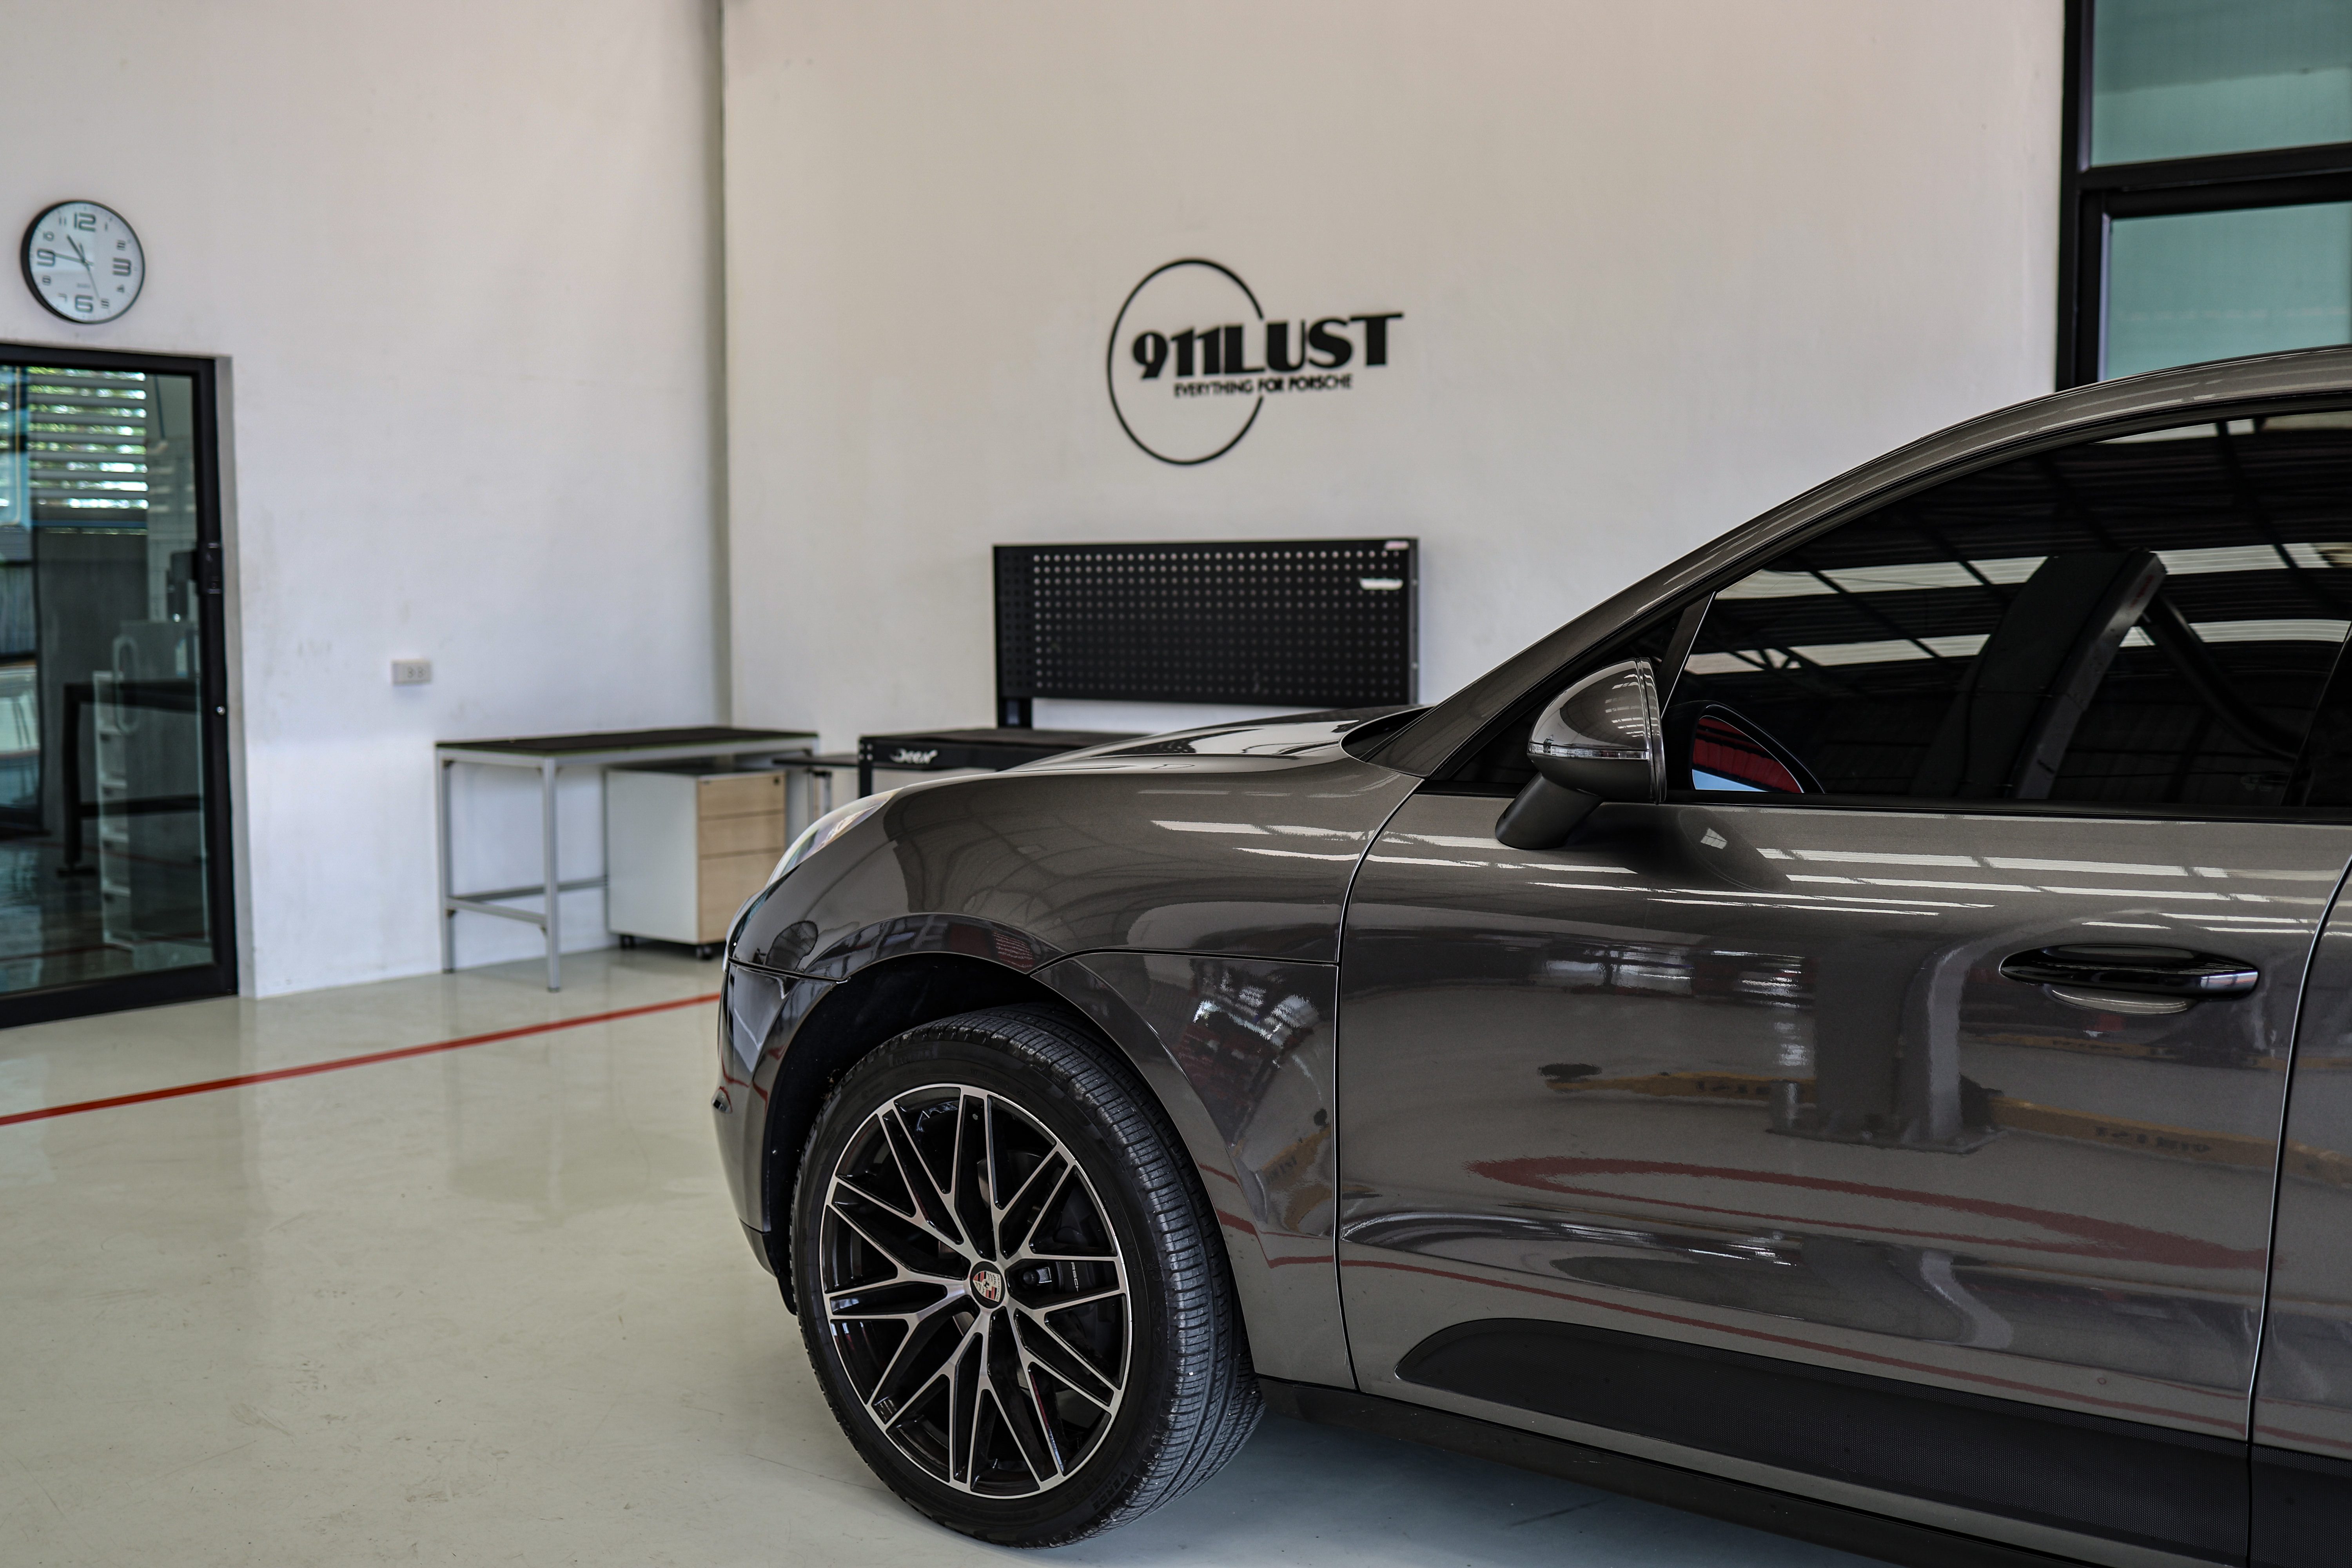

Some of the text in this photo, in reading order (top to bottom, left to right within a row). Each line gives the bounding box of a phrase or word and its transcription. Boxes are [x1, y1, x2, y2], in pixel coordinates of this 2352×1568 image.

[74, 212, 96, 232] 12
[37, 249, 55, 266] 9
[113, 258, 131, 276] 3
[75, 295, 93, 312] 6
[1132, 312, 1404, 379] 911LUST
[1174, 374, 1353, 397] EVERYTHING FOR PORSCHE
[1092, 1470, 1128, 1512] VERDE
